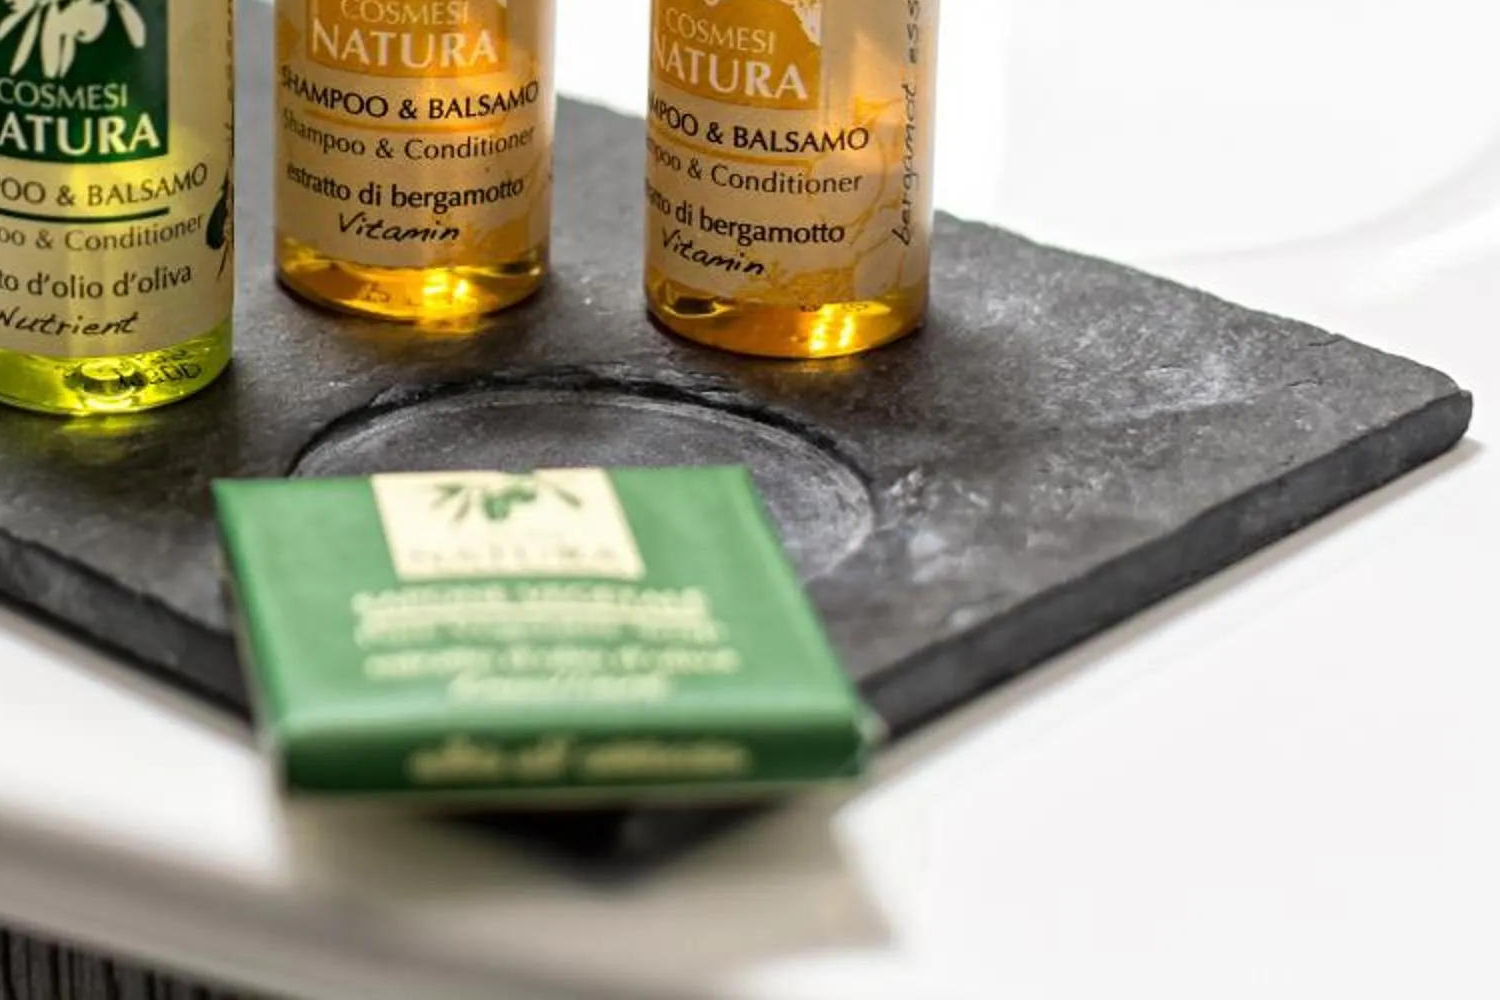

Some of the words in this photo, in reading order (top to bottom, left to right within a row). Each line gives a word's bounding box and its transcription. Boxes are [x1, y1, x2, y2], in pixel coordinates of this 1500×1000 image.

[312, 18, 498, 68] NATURA
[664, 6, 776, 56] COSMESI
[653, 26, 808, 100] NATURA
[282, 64, 388, 118] SHAMPOO
[399, 98, 417, 120] &
[429, 80, 539, 120] BALSAMO
[376, 138, 393, 159] &
[404, 123, 535, 161] Conditioner
[706, 121, 723, 144] &
[733, 126, 869, 153] BALSAMO
[57, 184, 76, 207] &
[88, 162, 208, 207] BALSAMO
[287, 162, 351, 201] estratto
[358, 181, 381, 207] di
[391, 174, 524, 214] bergamotto
[687, 158, 702, 180] &
[711, 162, 863, 194] Conditioner
[35, 228, 53, 249] &
[64, 212, 203, 251] Conditioner
[338, 211, 460, 243] Vitamin
[675, 200, 693, 226] di
[700, 205, 845, 247] bergamotto
[661, 228, 765, 276] Vitamin
[27, 271, 102, 299] d'olio
[112, 263, 192, 298] d'oliva
